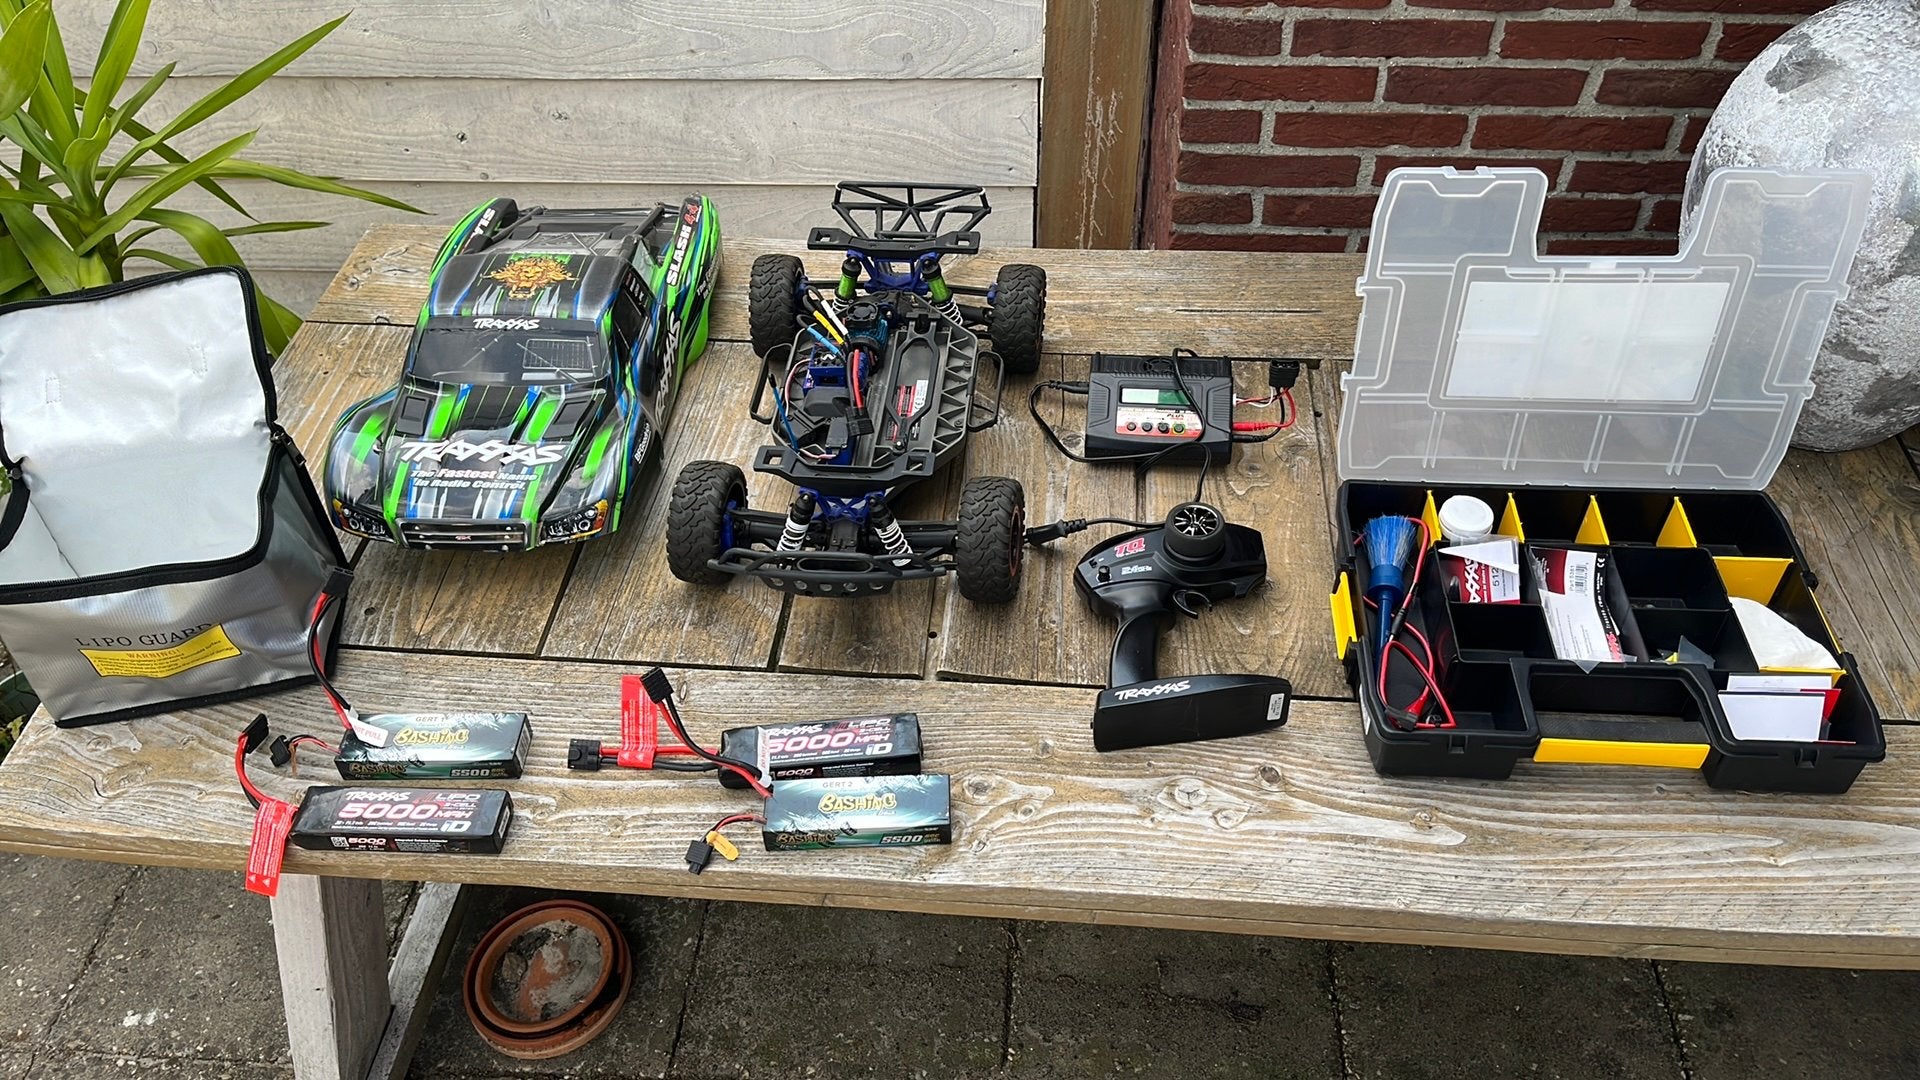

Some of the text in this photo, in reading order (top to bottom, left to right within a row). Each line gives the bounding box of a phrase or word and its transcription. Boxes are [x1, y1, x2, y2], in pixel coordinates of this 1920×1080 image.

[472, 208, 496, 236] SLA
[666, 224, 692, 286] SLASH
[472, 318, 541, 330] TRAXXAS
[655, 311, 681, 426] RAXXAS
[400, 439, 567, 466] TRAXXAS
[411, 468, 538, 481] The Fastest Name
[430, 479, 471, 488] Radio
[75, 635, 133, 647] LIPO
[126, 648, 180, 659] WARNING!
[1114, 680, 1191, 700] TRAXXAS
[766, 724, 823, 737] RAXXAS
[768, 731, 856, 754] 5000
[451, 769, 490, 777] 5500
[345, 791, 411, 801] TRAXXAS
[338, 803, 439, 820] 5000
[881, 835, 923, 844] 5500
